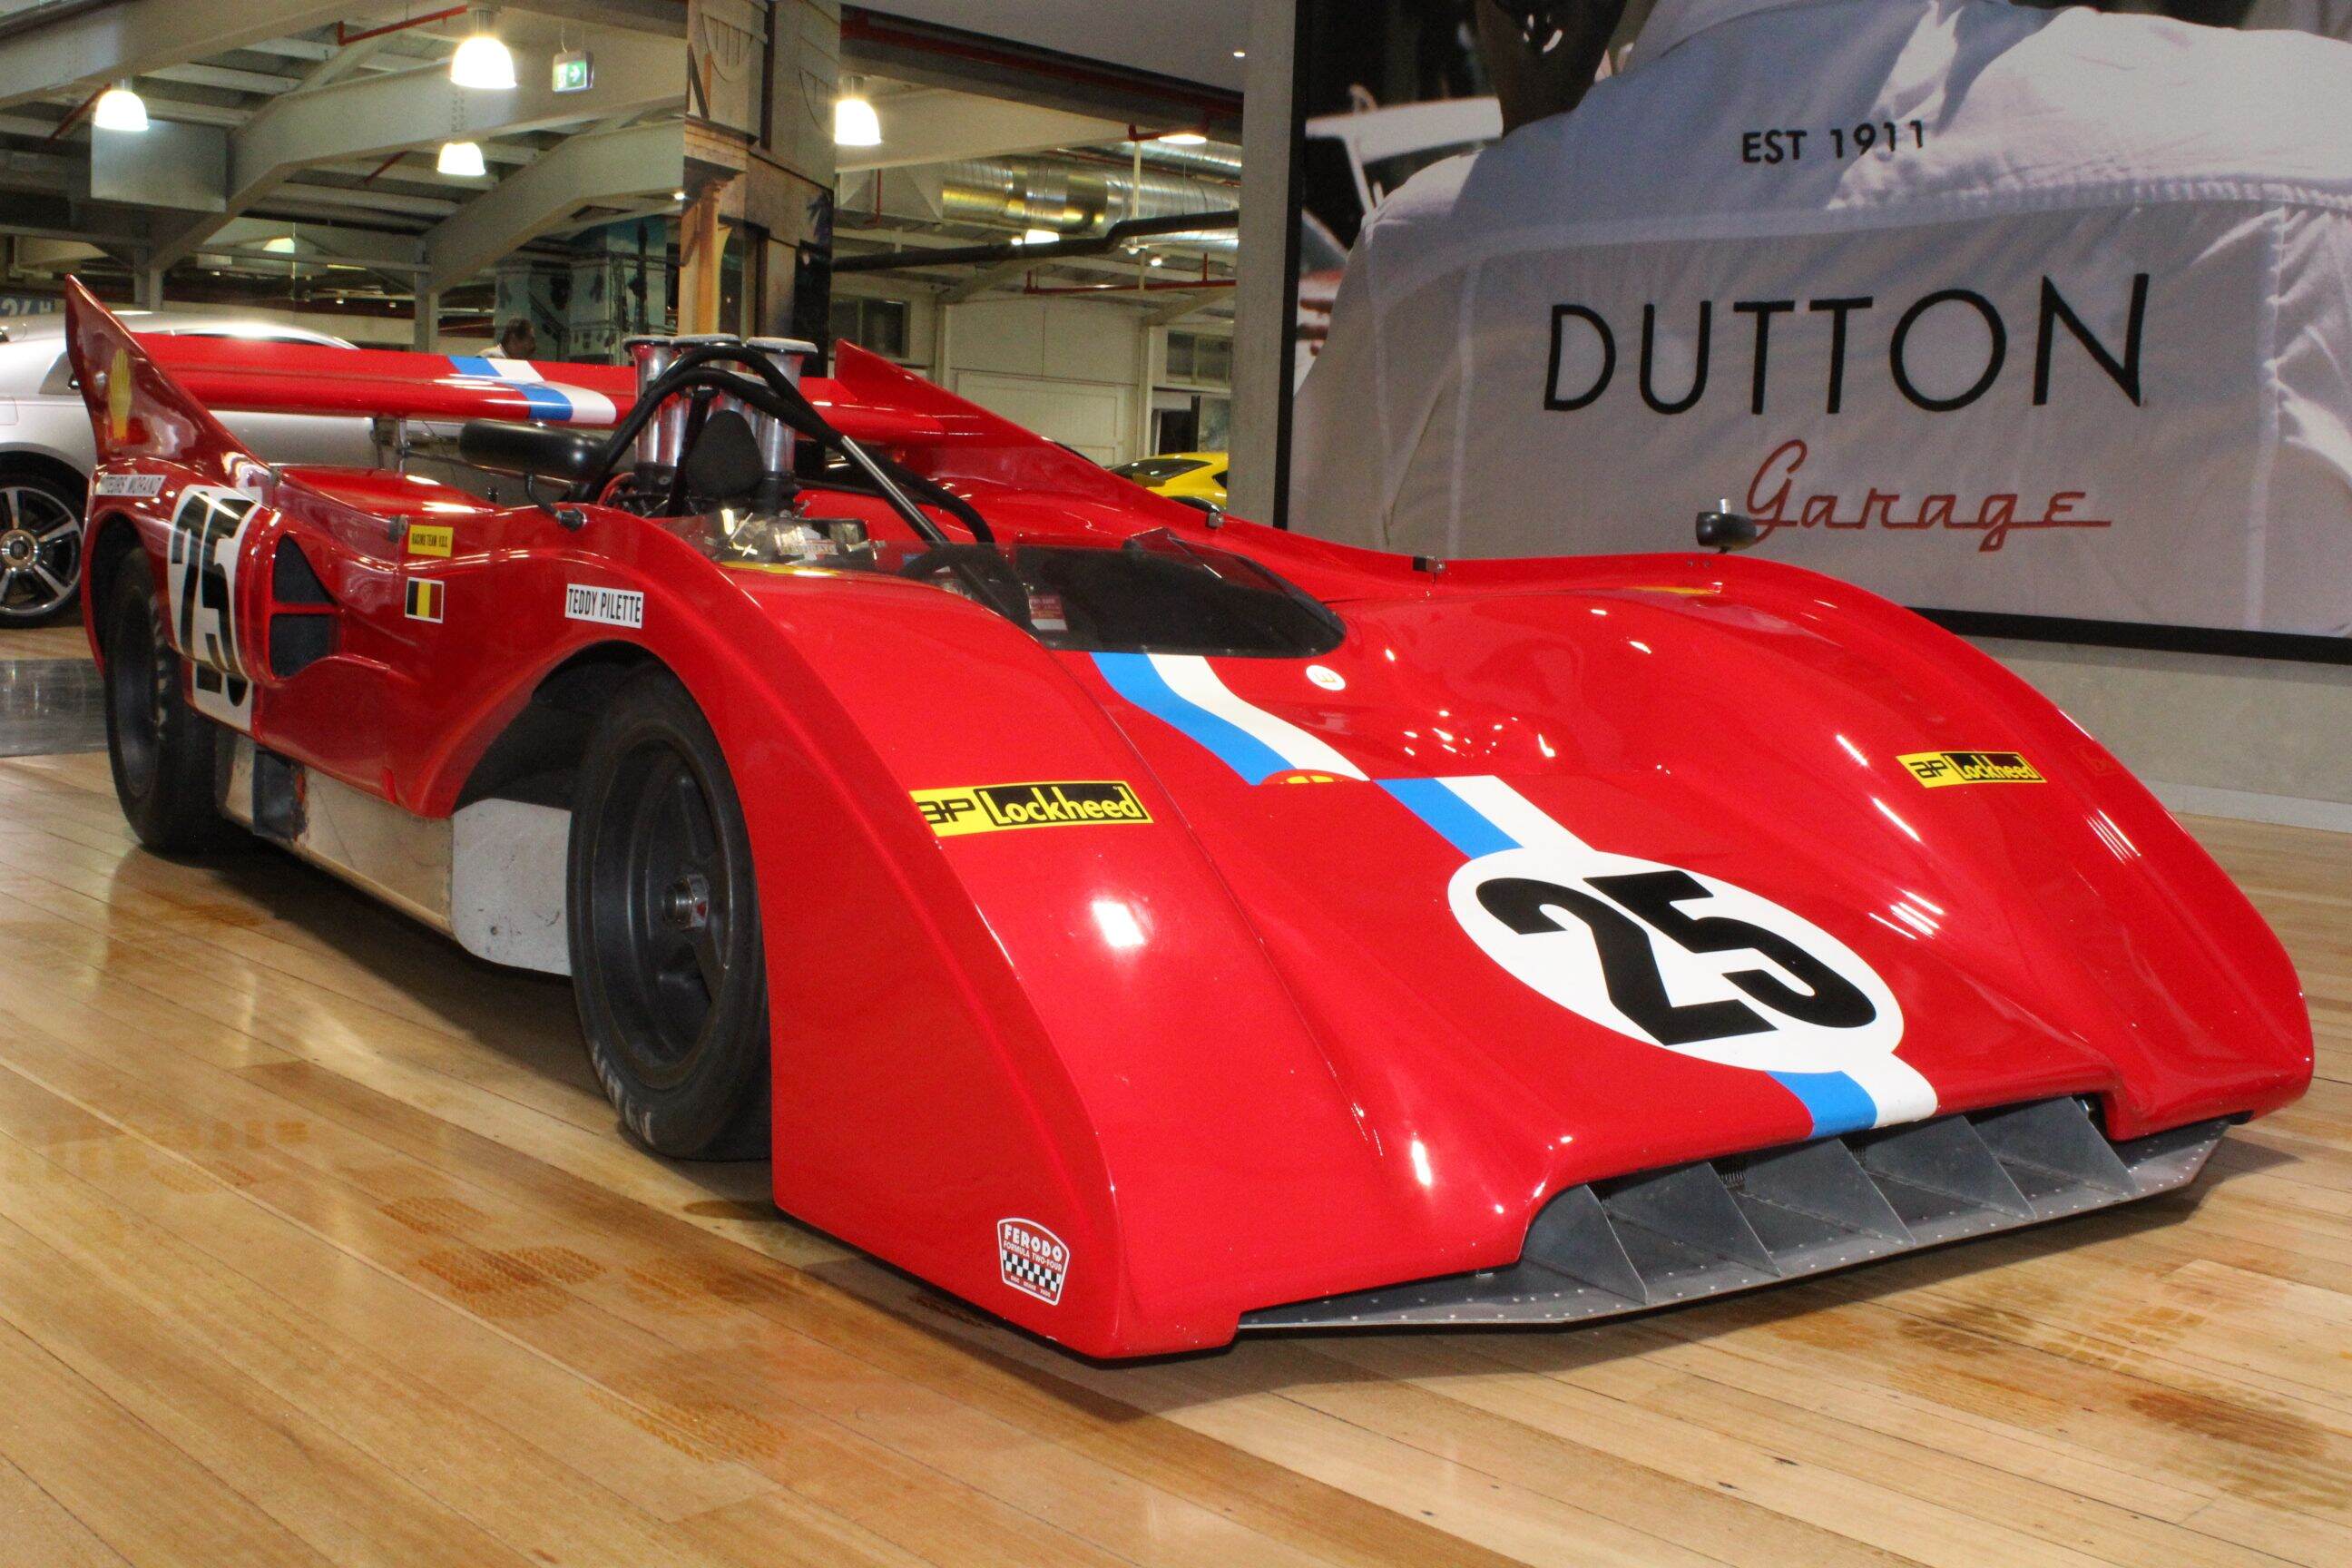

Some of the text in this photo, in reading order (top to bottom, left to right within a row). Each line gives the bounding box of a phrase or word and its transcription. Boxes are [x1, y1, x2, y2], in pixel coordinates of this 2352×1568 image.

[1742, 120, 1924, 164] EST 1911
[1544, 273, 2149, 415] DUTTON
[1747, 438, 2112, 552] Garage
[569, 588, 642, 622] TEDDY PILETTE
[1945, 754, 2041, 779] Lockheed
[978, 786, 1142, 824] Lockheed
[1475, 869, 1877, 1046] 25
[1003, 1240, 1030, 1258] FORMULA
[1004, 1223, 1063, 1262] FERODO
